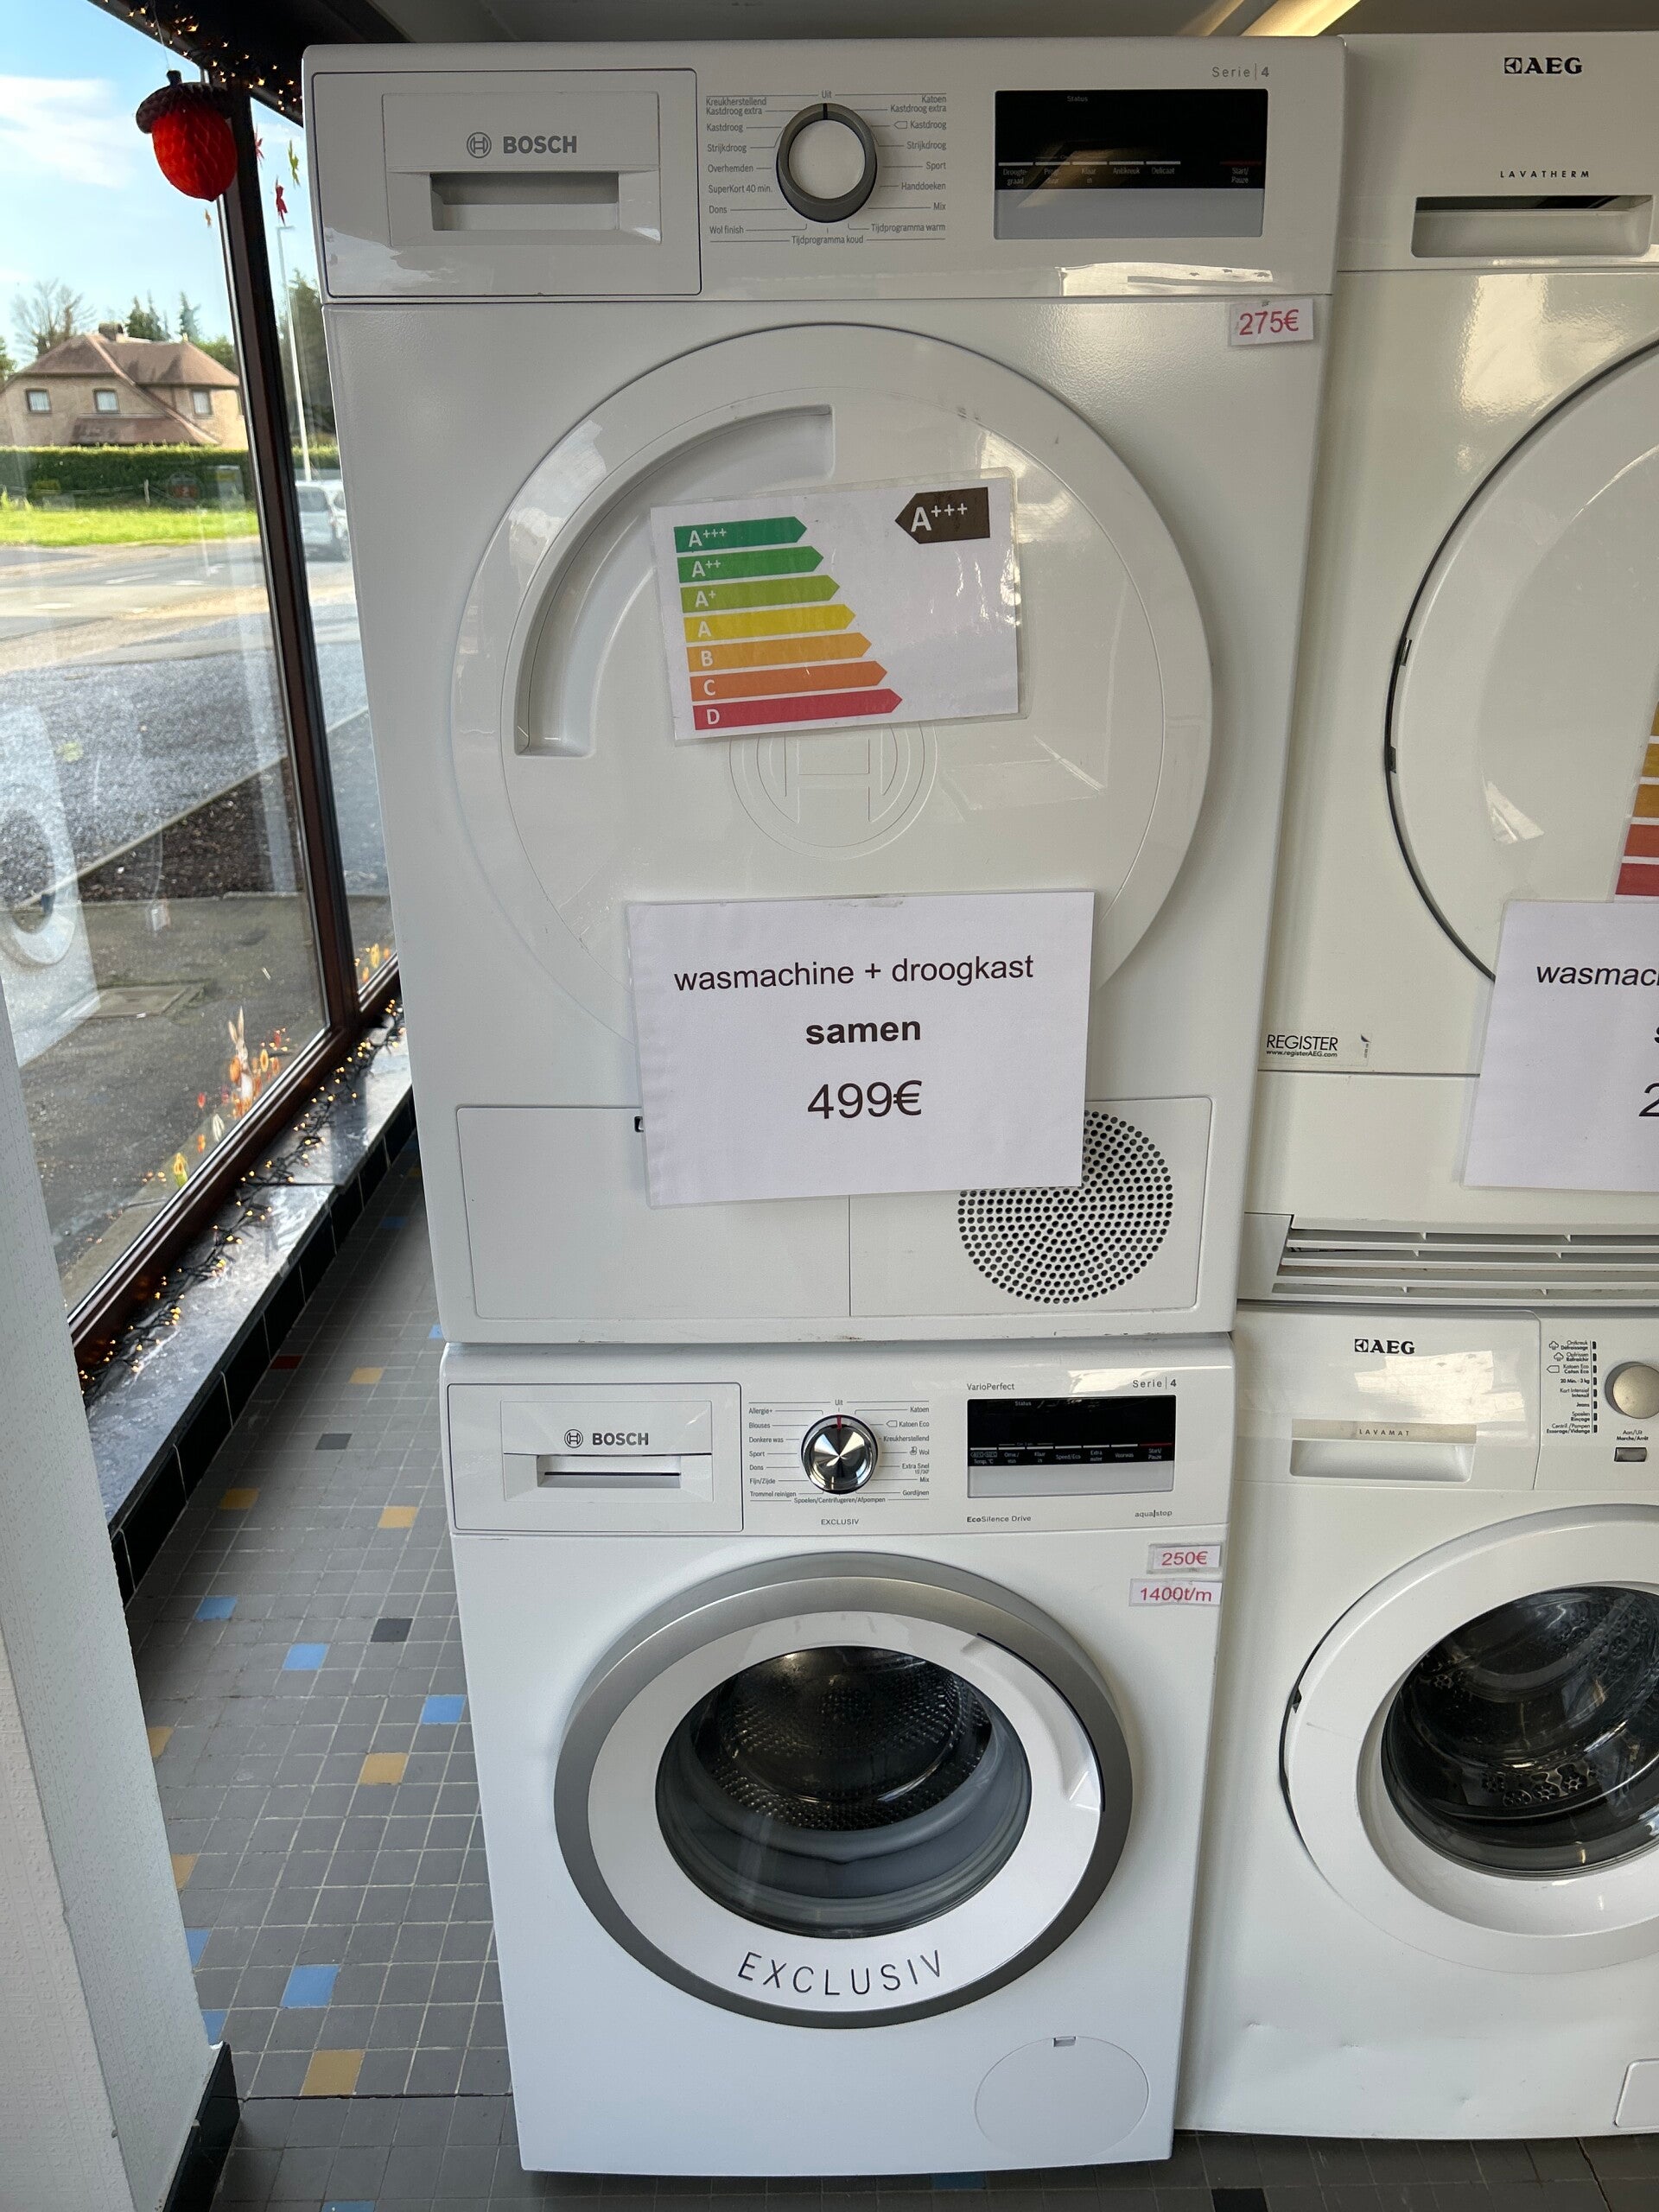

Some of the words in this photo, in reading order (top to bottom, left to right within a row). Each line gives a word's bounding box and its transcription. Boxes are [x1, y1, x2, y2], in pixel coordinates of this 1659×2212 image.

[1524, 57, 1582, 74] AEG
[1211, 66, 1251, 78] Serie
[821, 90, 832, 99] Uit
[921, 95, 947, 104] Katoen
[706, 97, 766, 106] Kreukherstellend
[706, 107, 742, 116] Kastdroog
[890, 104, 927, 114] Kastdroog
[706, 123, 743, 132] Kastdroog
[910, 120, 947, 130] Kastdroog
[503, 135, 577, 154] BOSCH
[707, 143, 747, 153] Strijkdroog
[906, 140, 947, 150] Strijkdroog
[708, 164, 753, 173] Overhemden
[926, 162, 946, 171] Sport
[708, 184, 744, 194] SuperKort
[901, 181, 946, 190] Handdoeken
[709, 226, 723, 234] Wol
[724, 226, 744, 234] finish
[871, 223, 925, 233] Tijdprogramma
[791, 235, 845, 246] Tijdprogramma
[846, 235, 864, 244] koud
[1239, 308, 1299, 335] 275€
[910, 502, 968, 533] A+++
[688, 527, 727, 548] A+++
[691, 558, 721, 578] A++
[695, 589, 716, 607] A+
[697, 621, 711, 638] A
[701, 650, 714, 667] B
[703, 679, 716, 696] C
[706, 709, 720, 725] D
[674, 959, 854, 991] wasmachine
[865, 963, 882, 980] +
[892, 954, 1033, 988] droogkast
[1536, 966, 1659, 987] wasmac
[806, 1020, 921, 1046] samen
[1266, 1033, 1338, 1052] REGISTER
[1266, 1049, 1338, 1058] www.registerAEG.com
[807, 1079, 922, 1120] 499€
[1370, 1339, 1415, 1355] AEG
[966, 1382, 1015, 1391] VarioPerfect
[1132, 1379, 1163, 1389] Serie
[748, 1407, 772, 1415] Allergie+
[1359, 1428, 1410, 1437] LAVAMAT
[592, 1432, 649, 1446] BOSCH
[774, 1491, 797, 1499] reinigen
[966, 1515, 1009, 1523] EcoSilence
[1161, 1550, 1208, 1566] 250€
[1140, 1586, 1212, 1602] 1400t/m
[737, 1950, 943, 1996] EXCLUSIV
